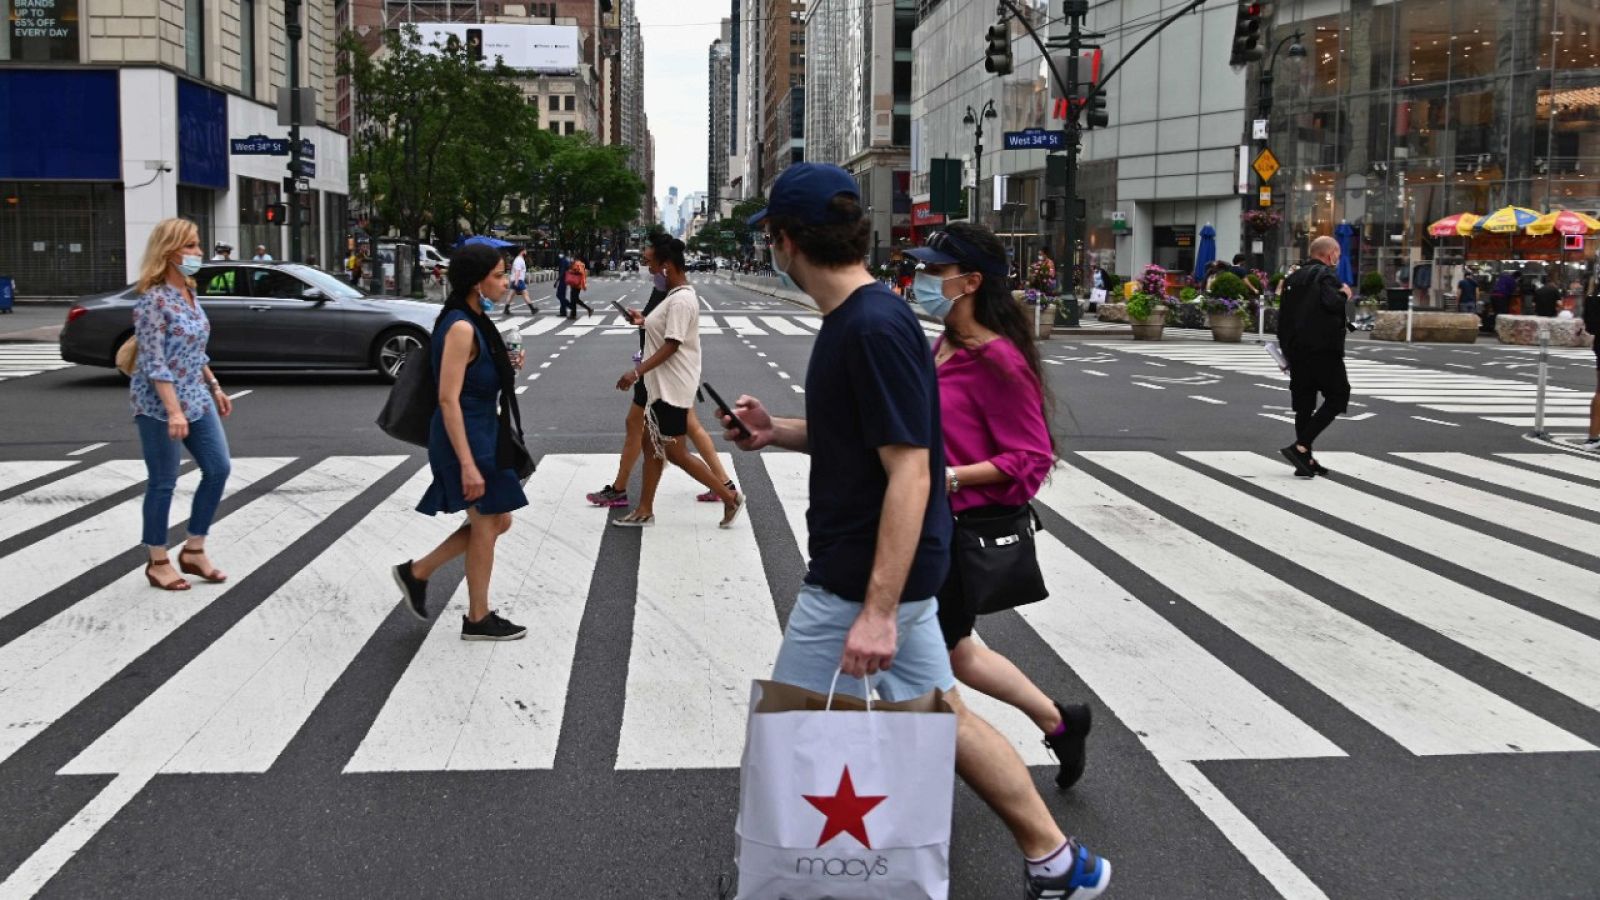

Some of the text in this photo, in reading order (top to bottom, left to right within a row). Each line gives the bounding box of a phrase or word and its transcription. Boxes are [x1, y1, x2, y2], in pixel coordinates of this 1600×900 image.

[15, 9, 45, 17] UP TO
[36, 18, 56, 27] OFF
[15, 28, 69, 37] EVERY DAY
[1009, 135, 1031, 145] West
[1049, 135, 1058, 144] St
[235, 143, 255, 151] West
[273, 143, 281, 151] St
[795, 855, 889, 882] macy's
